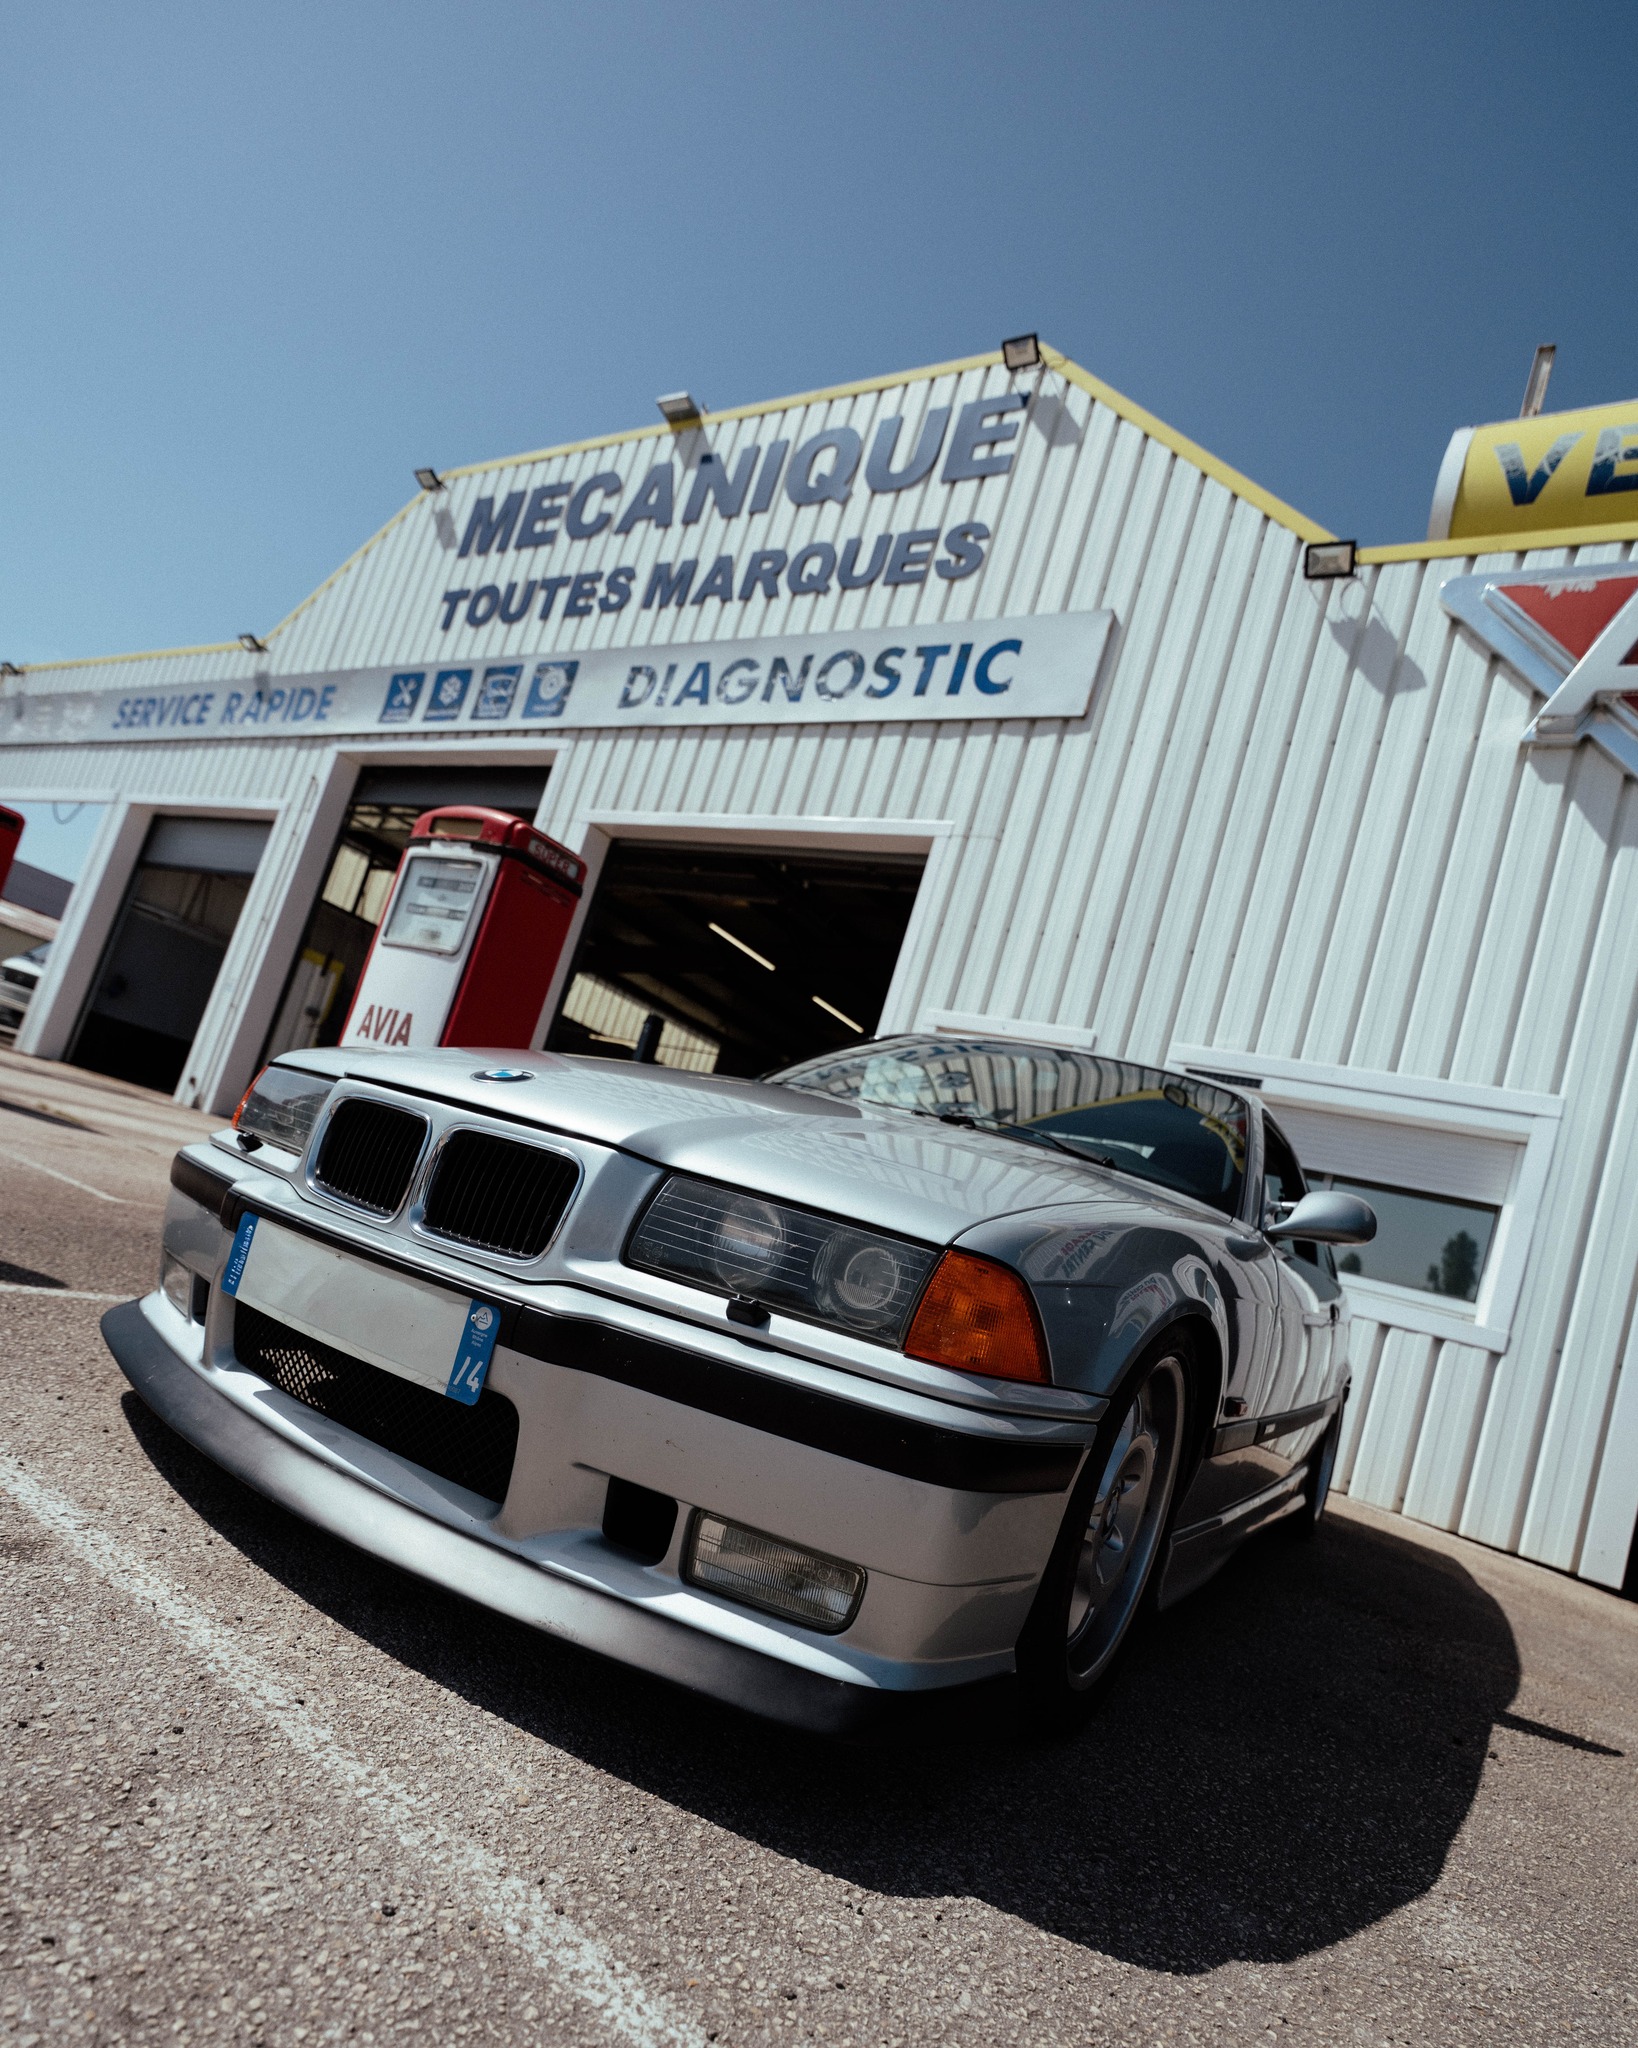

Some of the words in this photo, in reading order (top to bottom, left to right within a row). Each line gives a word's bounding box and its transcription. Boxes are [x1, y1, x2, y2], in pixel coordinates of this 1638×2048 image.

[458, 394, 1025, 558] MECANIQUE
[442, 566, 636, 631] TOUTES
[643, 522, 990, 610] MARQUES
[617, 637, 1023, 710] DIAGNOSTIC
[111, 692, 217, 730] SERVICE
[221, 684, 338, 725] RAPIDE
[536, 843, 570, 873] SUPER
[356, 1004, 413, 1047] AVIA
